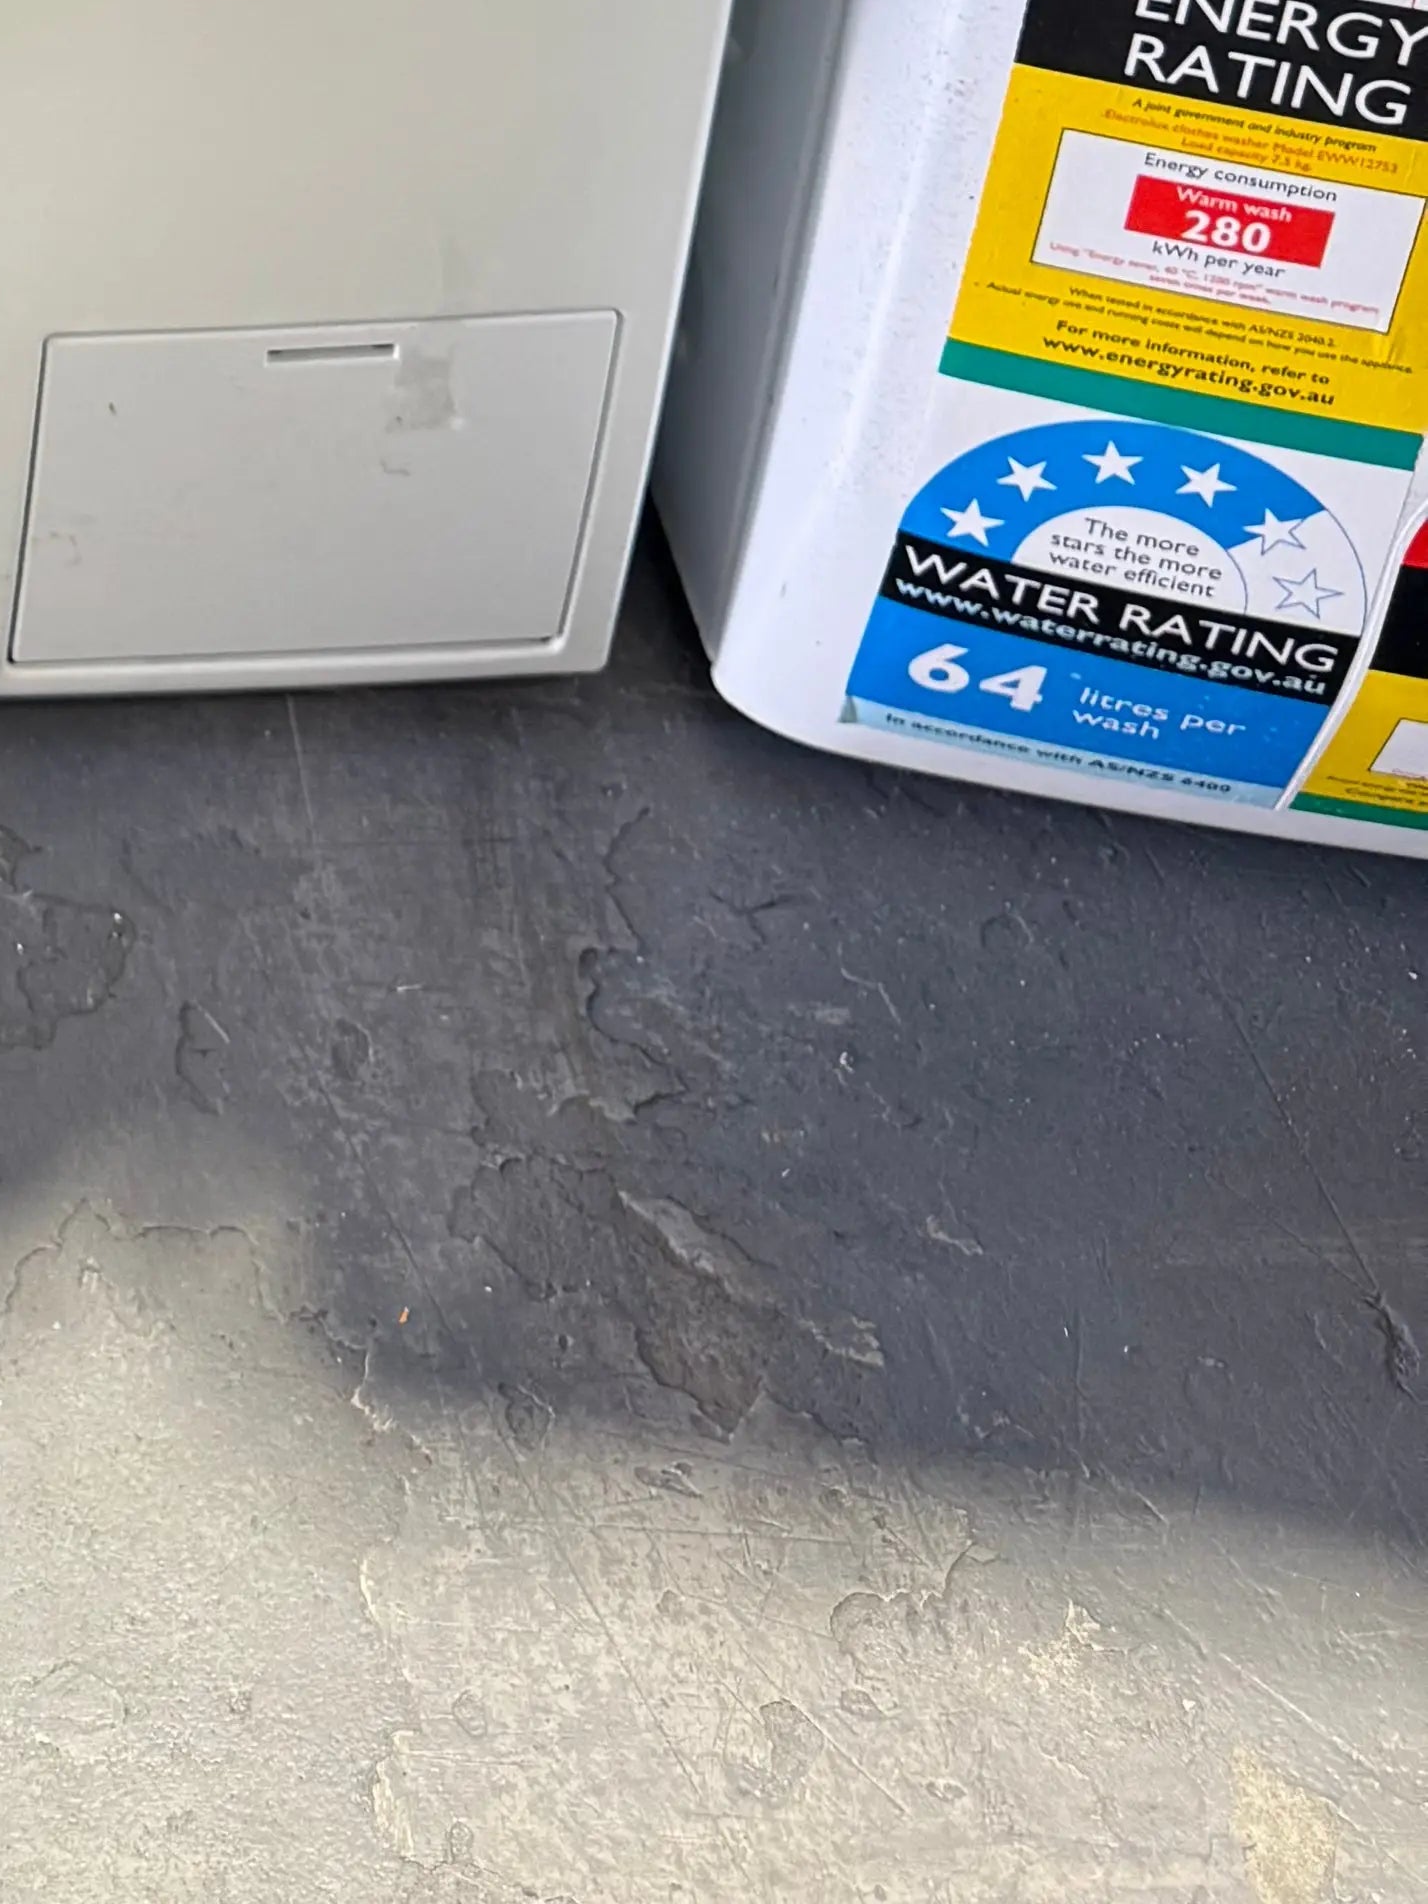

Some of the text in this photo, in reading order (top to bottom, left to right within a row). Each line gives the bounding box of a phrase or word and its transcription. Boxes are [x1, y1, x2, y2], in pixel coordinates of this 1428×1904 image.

[1124, 33, 1411, 126] RATING
[1144, 152, 1337, 202] Energy consumption
[1176, 186, 1292, 223] Warm wash
[1181, 212, 1272, 253] 280
[1152, 242, 1199, 264] kWh
[1204, 253, 1239, 273] per
[1244, 261, 1285, 279] year
[1043, 337, 1334, 406] www.energyrating.gov.au
[1056, 321, 1087, 337] For
[1098, 328, 1141, 349] more
[1261, 358, 1306, 380] refer
[1051, 535, 1222, 580] stars the more
[1085, 518, 1199, 555] The more
[1050, 553, 1215, 598] water efficient
[905, 545, 1338, 672] WATER RATING
[896, 577, 1325, 694] www.waterrating.gov.au
[908, 644, 1246, 737] 64 litres per
[911, 721, 1030, 753] accordance
[1072, 709, 1160, 740] wash
